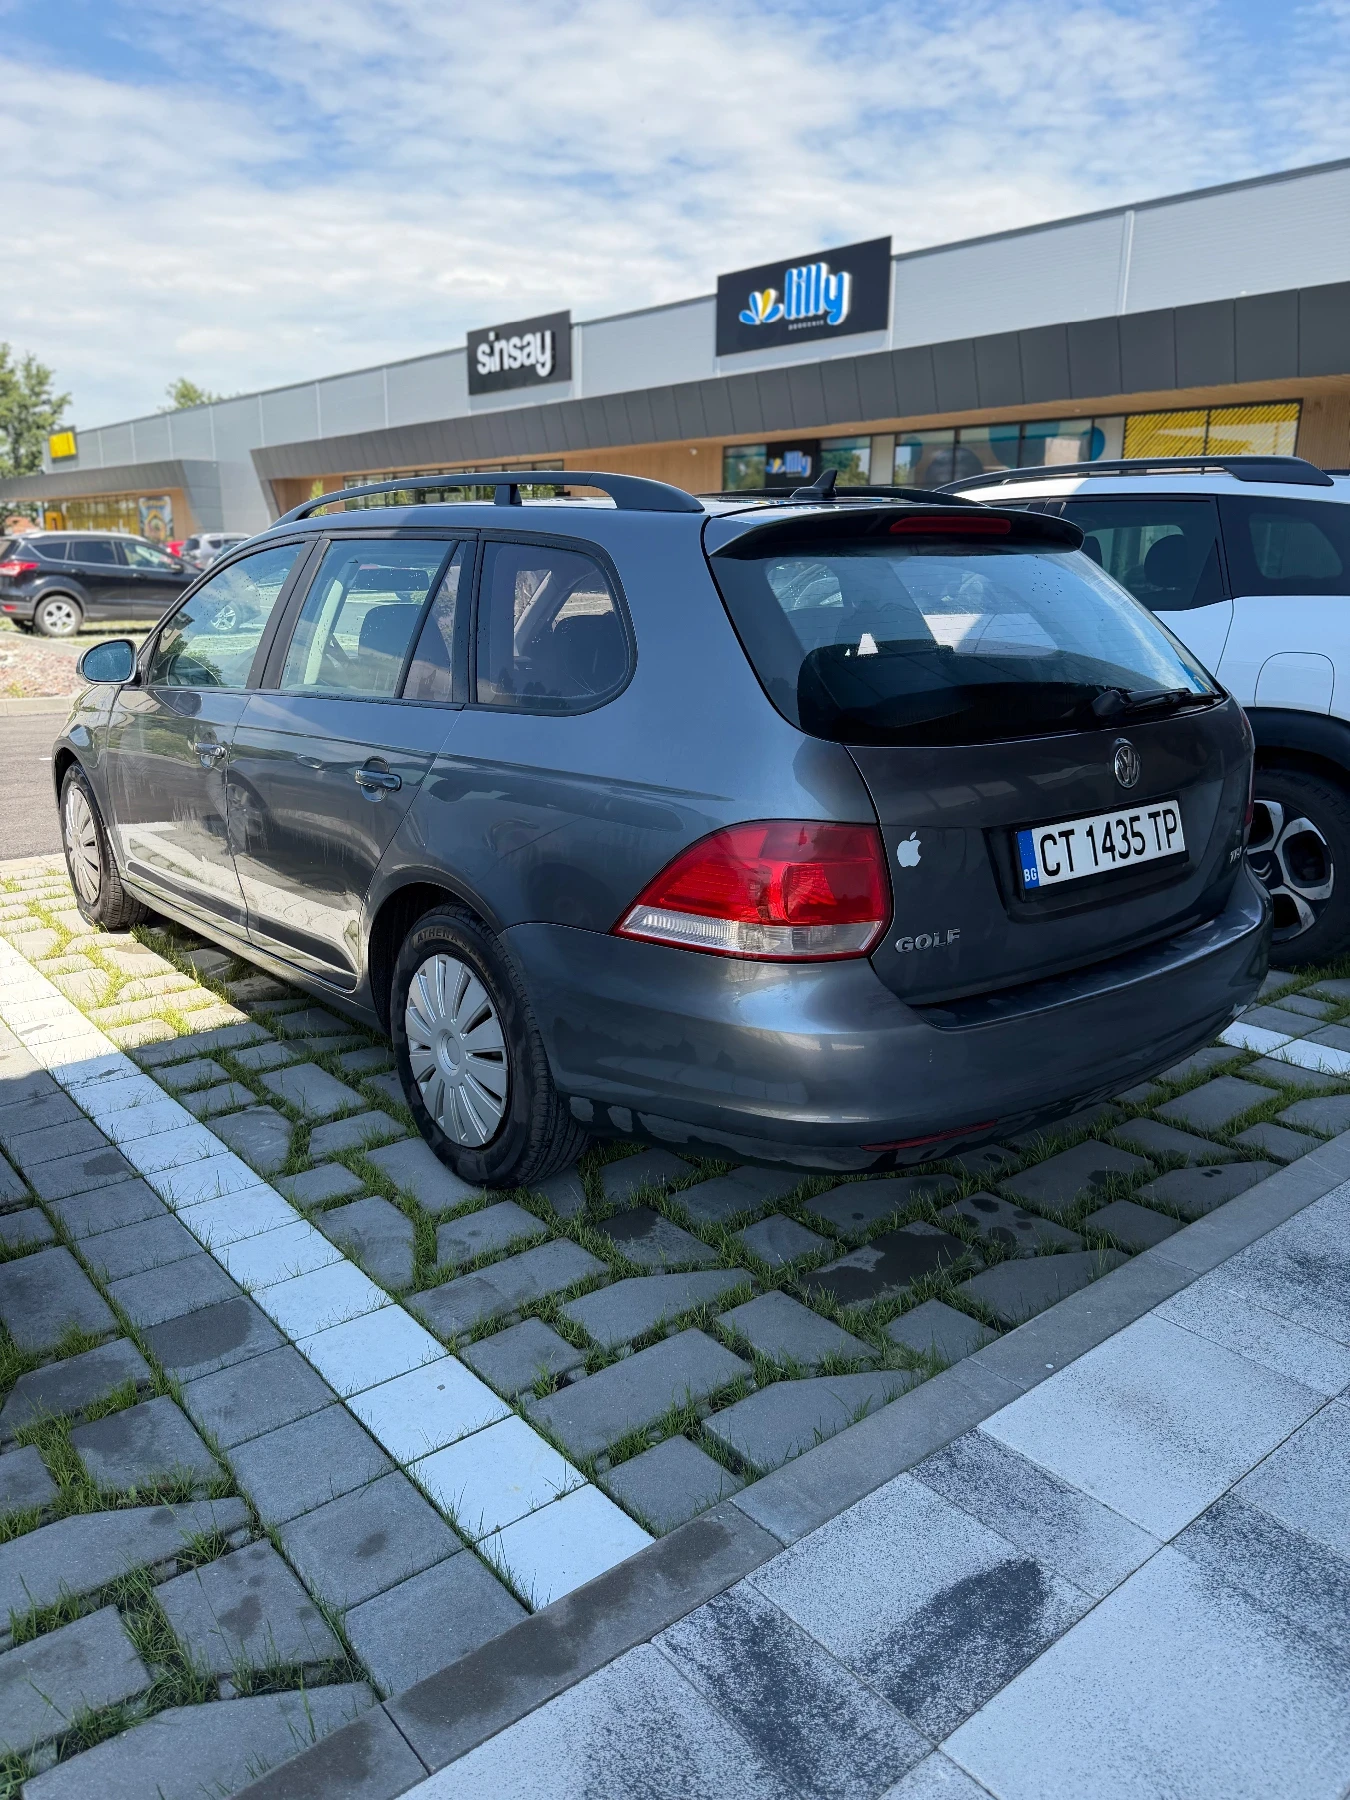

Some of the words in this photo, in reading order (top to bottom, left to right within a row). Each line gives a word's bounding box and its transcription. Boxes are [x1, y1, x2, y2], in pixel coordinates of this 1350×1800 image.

[783, 262, 852, 325] lilly
[476, 329, 552, 377] sinsay
[1040, 828, 1076, 877] CT
[1085, 815, 1146, 867] 1435
[1147, 808, 1178, 852] TP
[1023, 868, 1038, 882] BG
[416, 927, 458, 944] ATHENA
[894, 927, 961, 953] GOLF
